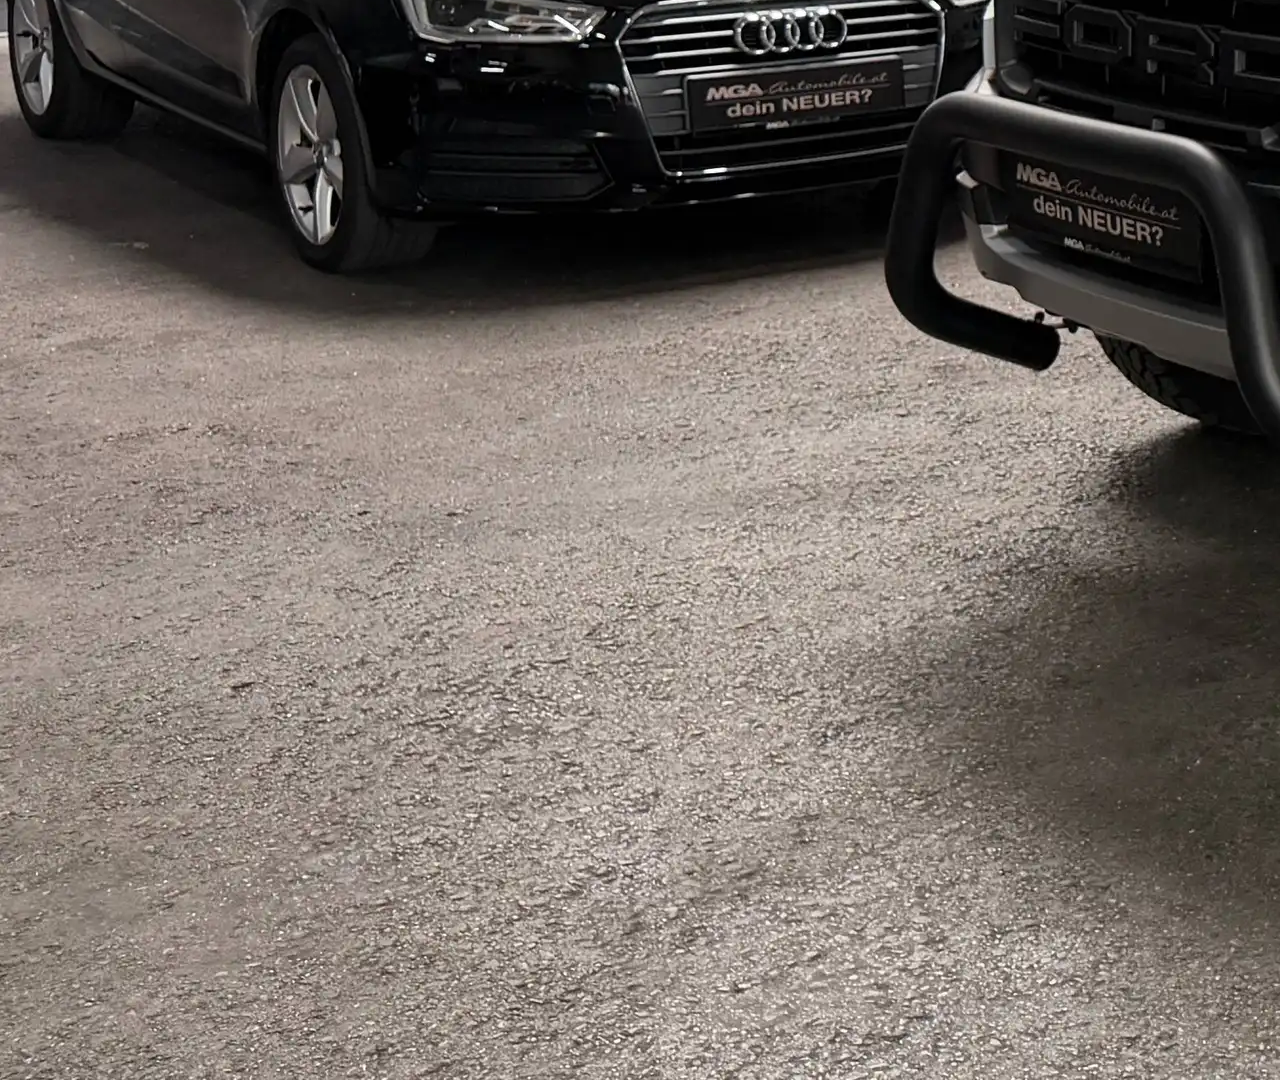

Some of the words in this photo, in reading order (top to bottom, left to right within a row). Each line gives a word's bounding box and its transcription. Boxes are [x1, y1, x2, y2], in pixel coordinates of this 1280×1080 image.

[705, 82, 764, 102] MGA
[726, 98, 776, 118] dein
[782, 88, 873, 112] NEUER?
[766, 120, 790, 130] MGA
[1015, 161, 1063, 192] MGA
[1032, 195, 1073, 223] dein
[1077, 206, 1164, 247] NEUER?
[1064, 236, 1085, 251] MGA
